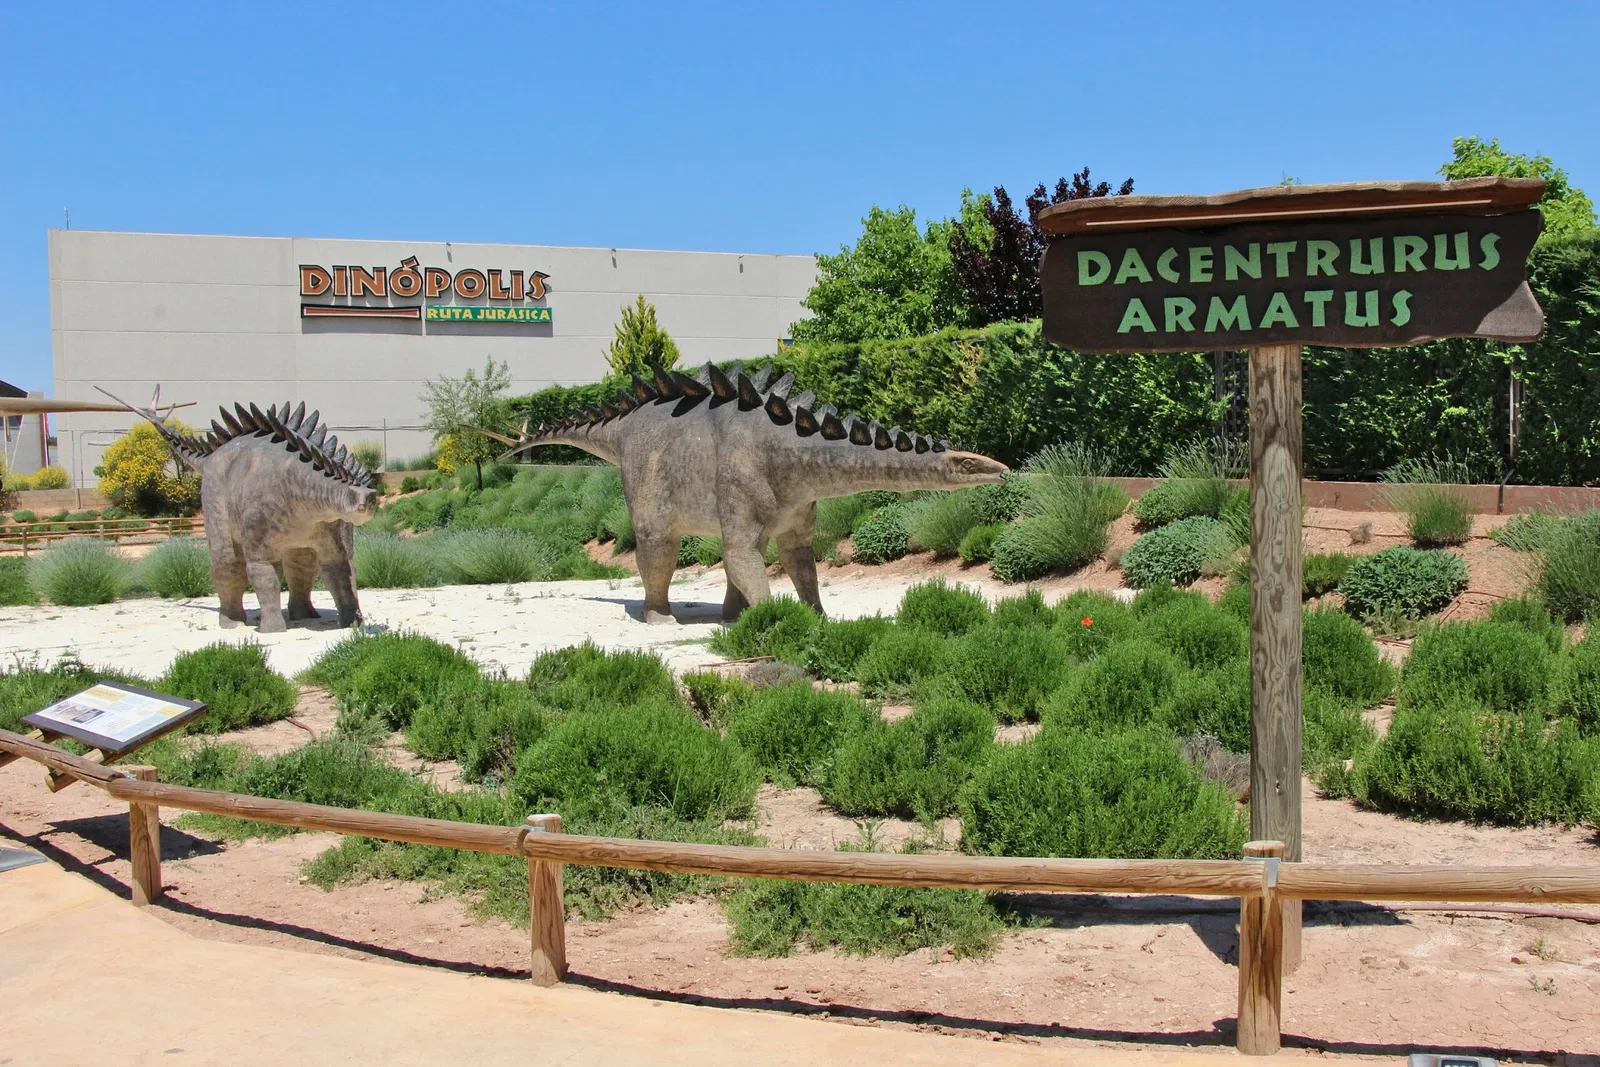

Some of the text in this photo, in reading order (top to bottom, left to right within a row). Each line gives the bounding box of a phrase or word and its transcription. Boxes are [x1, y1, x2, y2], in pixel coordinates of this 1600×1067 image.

[299, 255, 551, 300] DINÓPOLIS
[1077, 231, 1501, 286] DACENTRURUS
[426, 308, 473, 319] RUTA
[1117, 289, 1413, 333] ARMATUS
